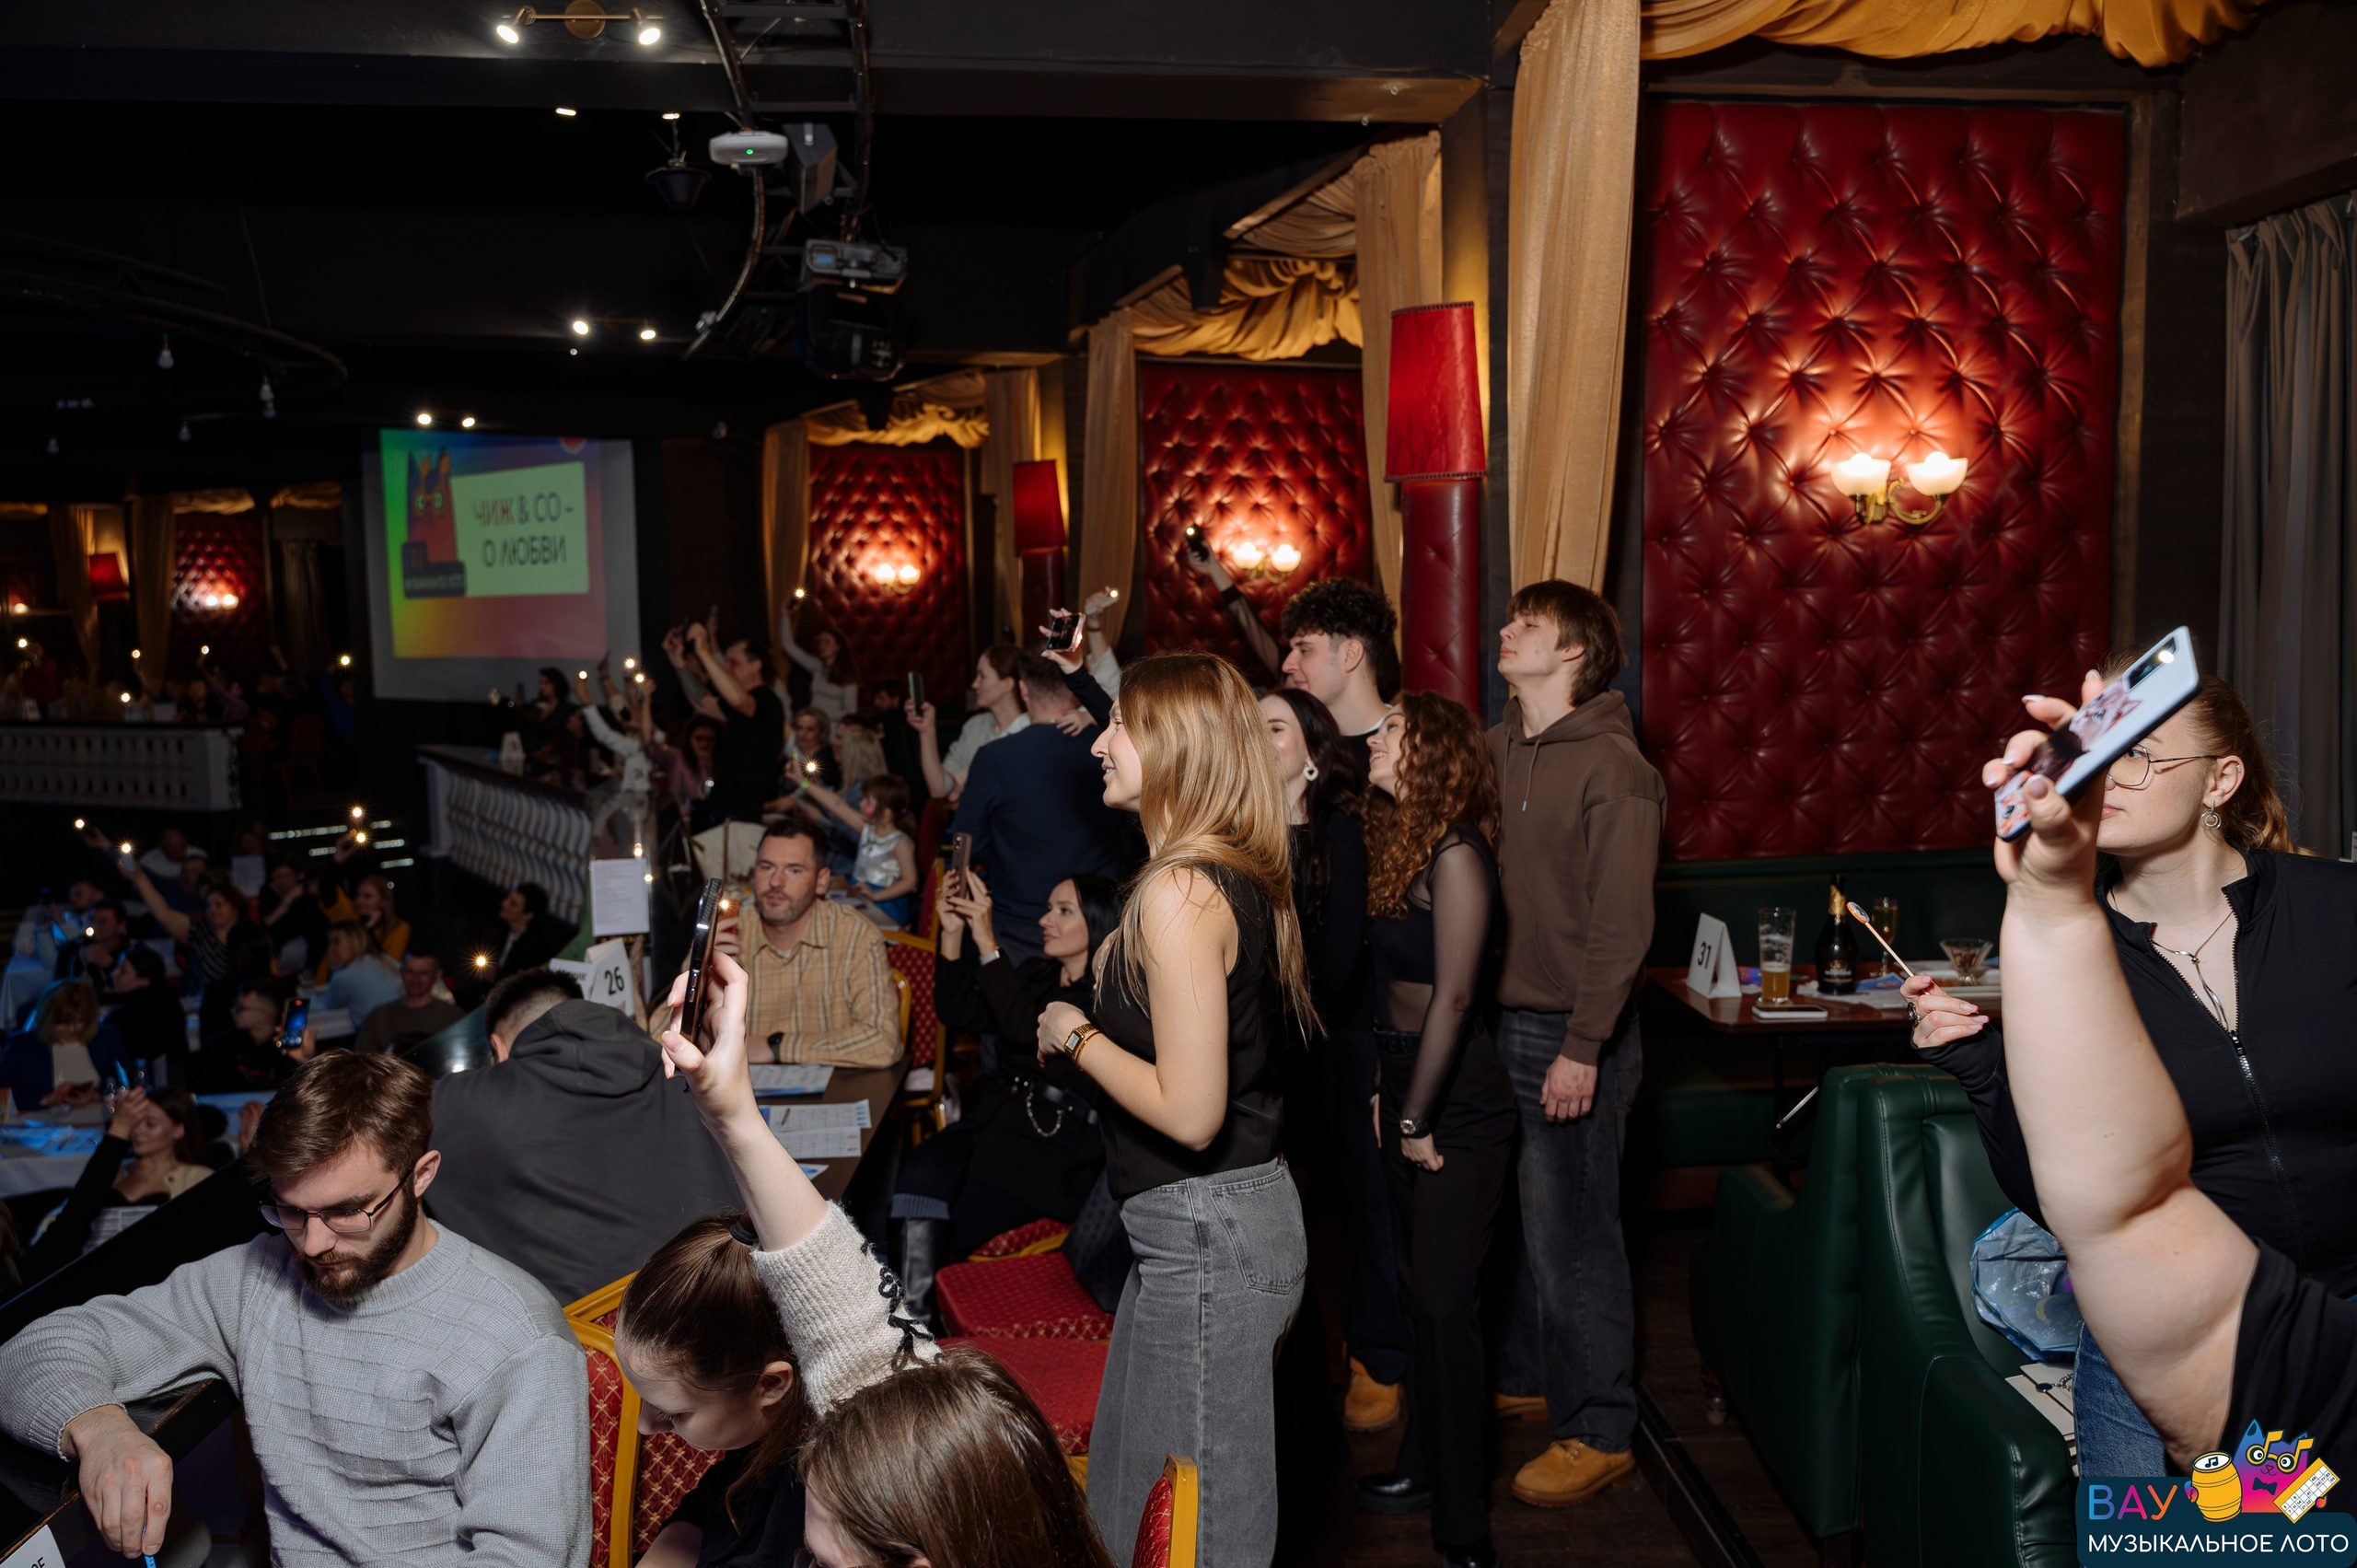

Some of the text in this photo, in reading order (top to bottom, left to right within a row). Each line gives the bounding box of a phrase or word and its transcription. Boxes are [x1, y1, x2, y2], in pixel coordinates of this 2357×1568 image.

[473, 499, 515, 526] ЧИЖ
[483, 535, 567, 568] О ЛЮБВИ
[1698, 941, 1712, 970] 31
[604, 967, 625, 996] 26
